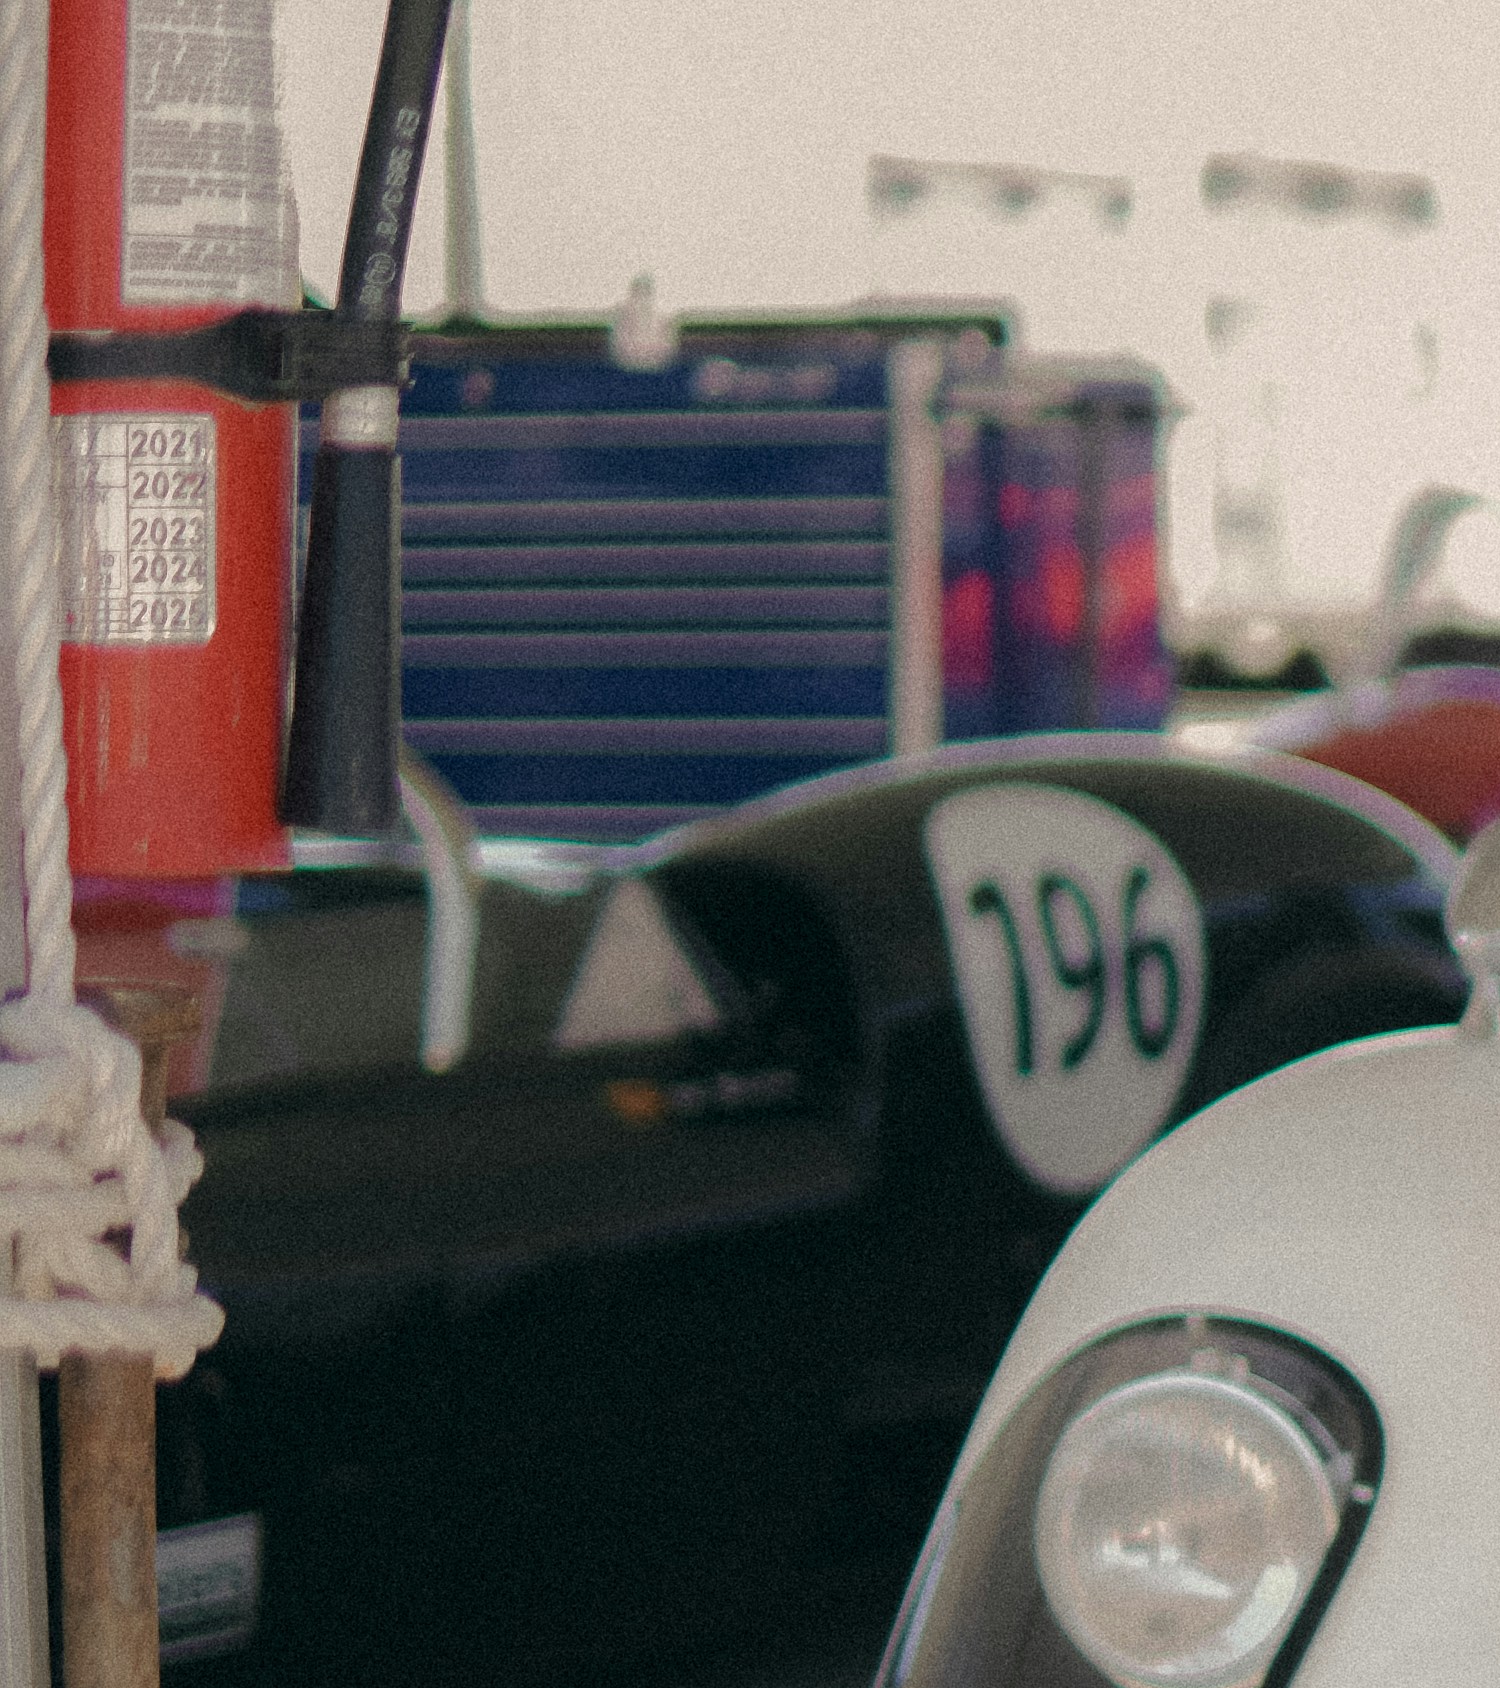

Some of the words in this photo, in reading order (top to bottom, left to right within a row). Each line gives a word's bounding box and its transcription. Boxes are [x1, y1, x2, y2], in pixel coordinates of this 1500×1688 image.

[131, 429, 206, 458] 2021
[132, 471, 208, 500] 2022
[131, 517, 205, 546] 2023
[131, 555, 207, 584] 2024
[968, 865, 1180, 1073] 196
